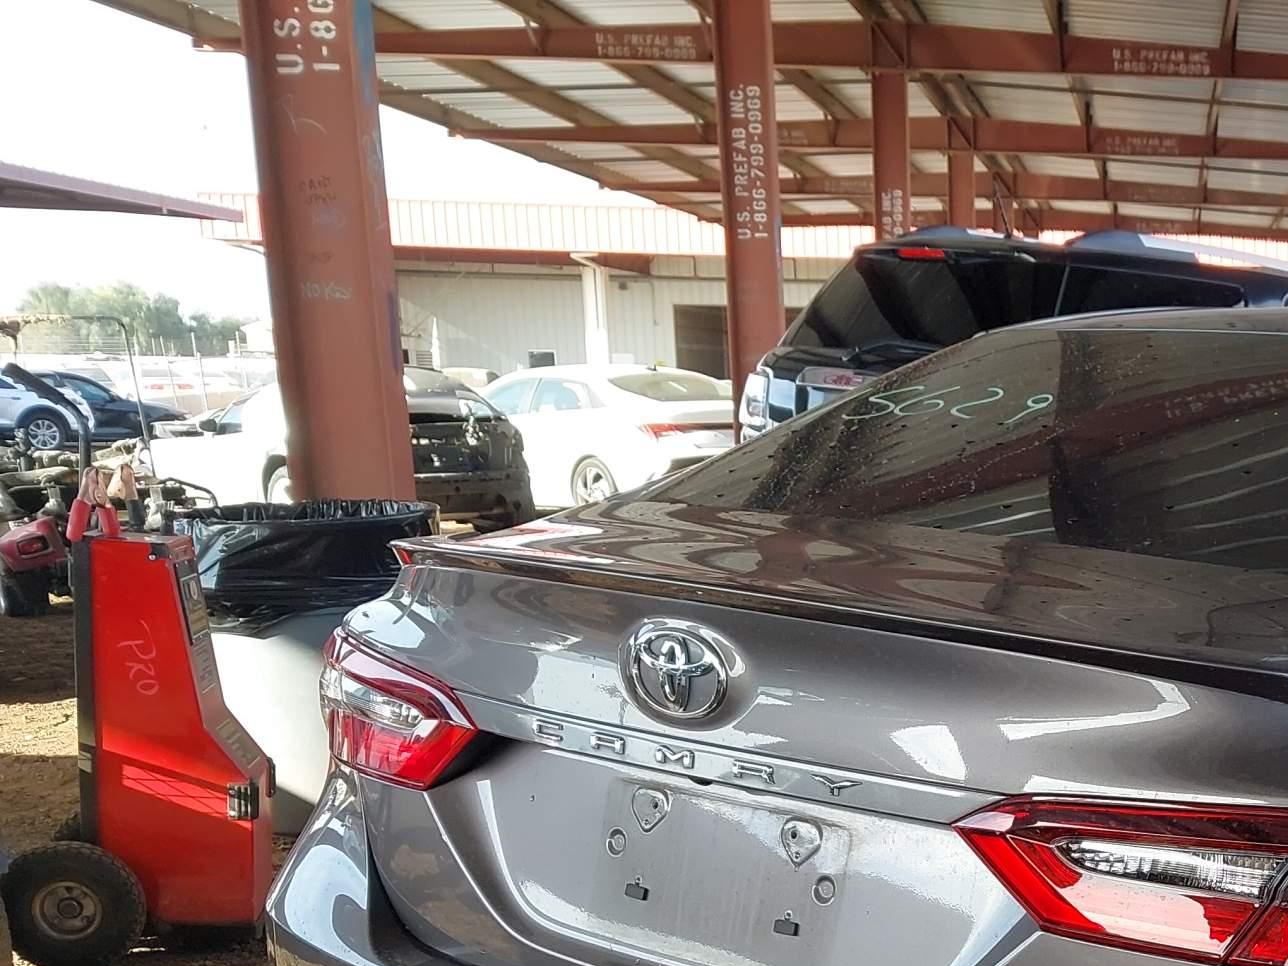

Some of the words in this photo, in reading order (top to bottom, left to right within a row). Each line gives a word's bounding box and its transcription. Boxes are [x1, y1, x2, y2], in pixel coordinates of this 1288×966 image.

[273, 6, 304, 75] U.S.
[729, 84, 745, 118] INC.
[731, 127, 749, 197] PREFAB
[746, 85, 768, 238] 1-866-799-0969
[736, 205, 752, 239] U.S.
[116, 620, 160, 695] PRO
[532, 717, 864, 797] CAMRY
